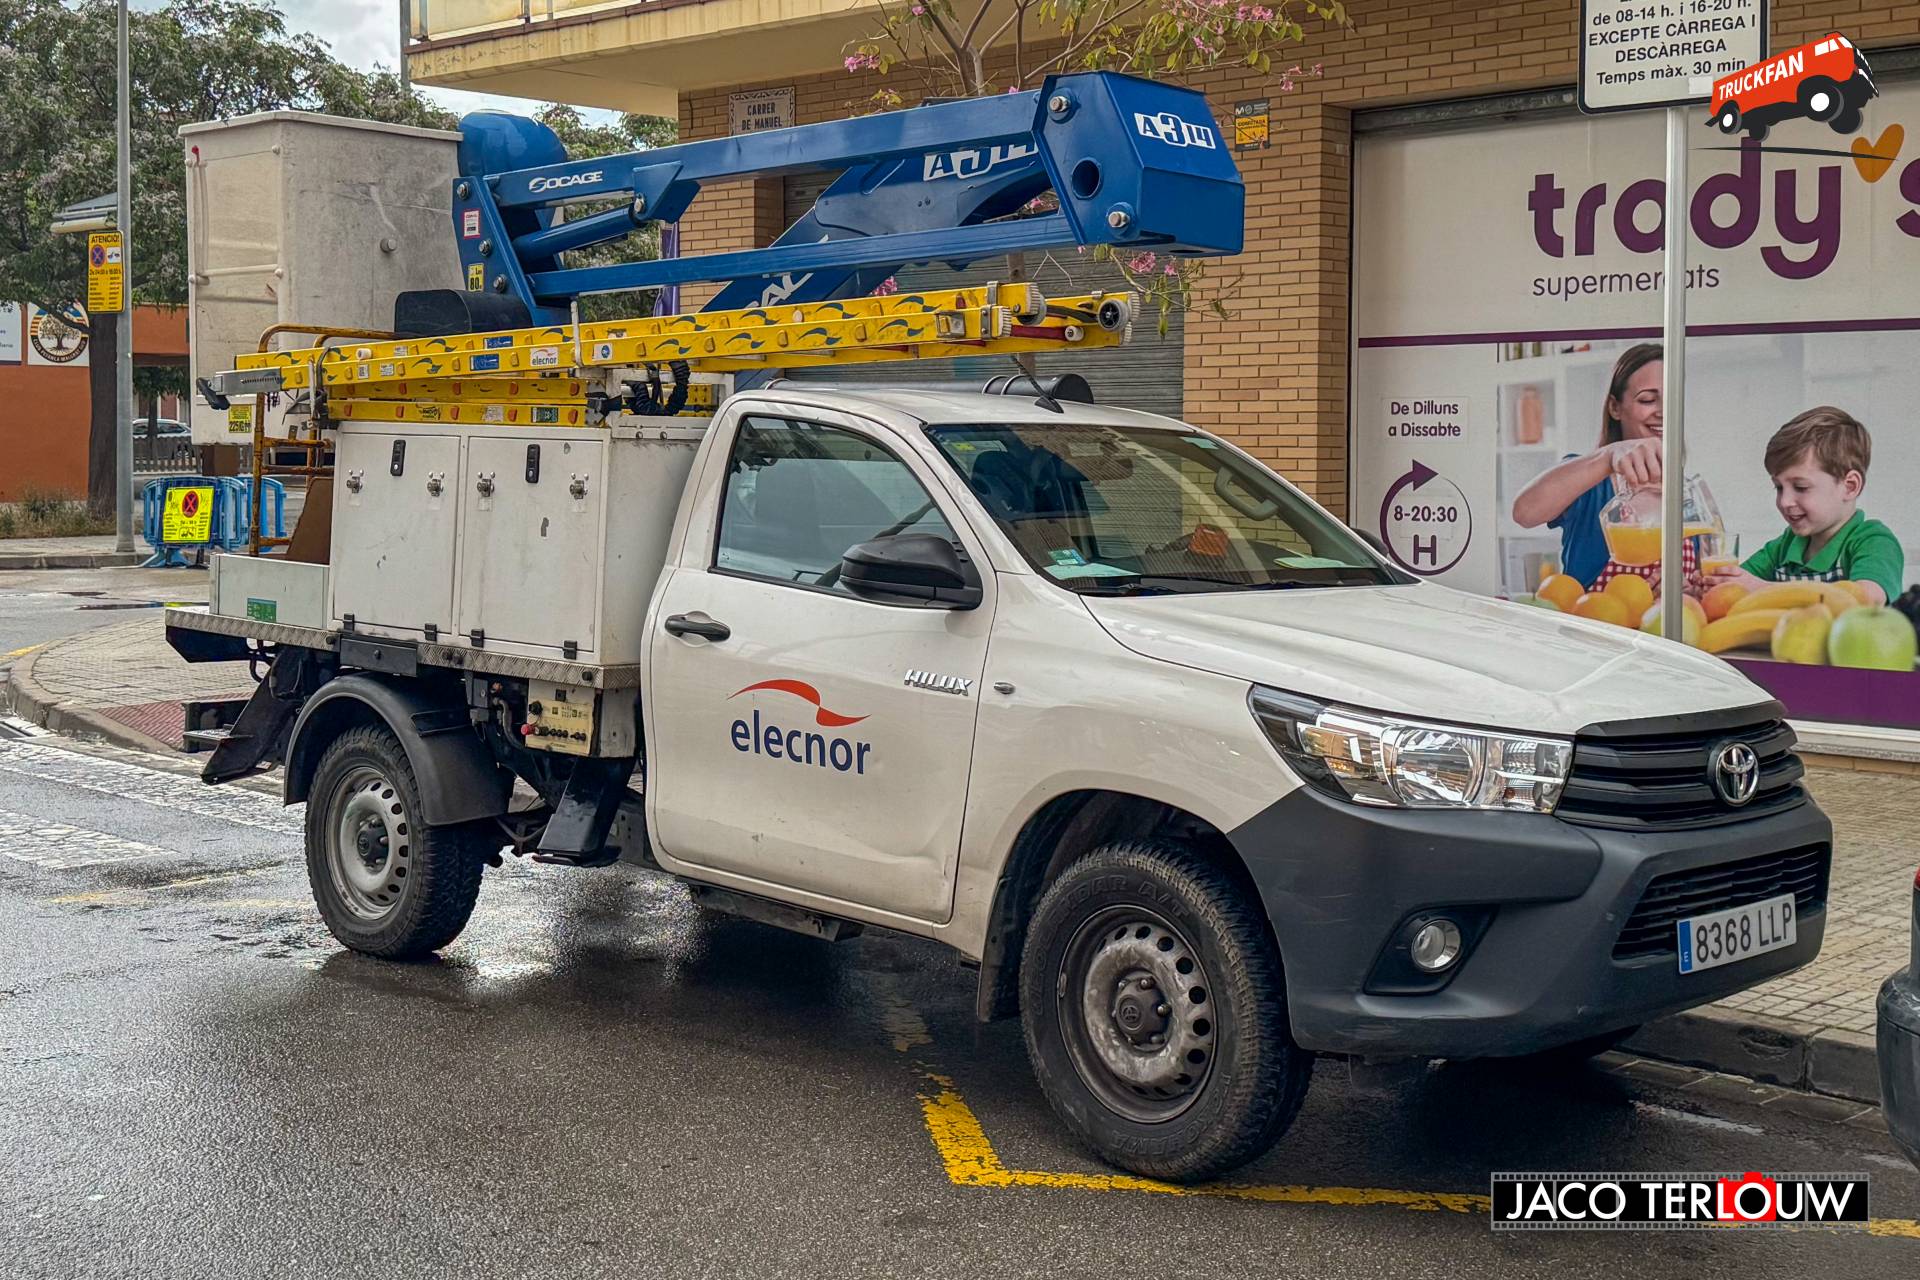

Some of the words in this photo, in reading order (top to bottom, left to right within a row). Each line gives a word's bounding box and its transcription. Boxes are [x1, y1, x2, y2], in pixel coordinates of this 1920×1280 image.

[1592, 12, 1610, 26] de
[1615, 7, 1656, 23] 08-14
[1660, 3, 1674, 17] h.
[1679, 2, 1684, 15] i
[1690, 0, 1731, 14] 16-20
[1589, 26, 1660, 46] EXCEPTE
[1665, 15, 1746, 37] CÀRREGA
[1752, 14, 1756, 28] I
[1615, 38, 1727, 63] DESCÀRREGA
[1596, 67, 1645, 86] Temps
[1650, 62, 1687, 80] màx.
[1693, 61, 1712, 75] 30
[747, 102, 776, 116] CARRER
[741, 119, 751, 130] DE
[754, 116, 783, 129] MANUEL
[529, 171, 603, 192] SOCAGE
[1532, 264, 1720, 302] supermerats
[532, 356, 557, 366] elecnor
[1390, 401, 1410, 415] De
[1413, 400, 1459, 415] Dilluns
[1388, 426, 1397, 437] a
[1401, 422, 1461, 437] Dissabte
[1393, 505, 1458, 523] 8-20:30
[1412, 534, 1437, 566] H
[903, 669, 974, 696] HILUX
[730, 709, 871, 775] elecnor
[1696, 914, 1751, 963] 8368
[1758, 902, 1792, 947] LLP
